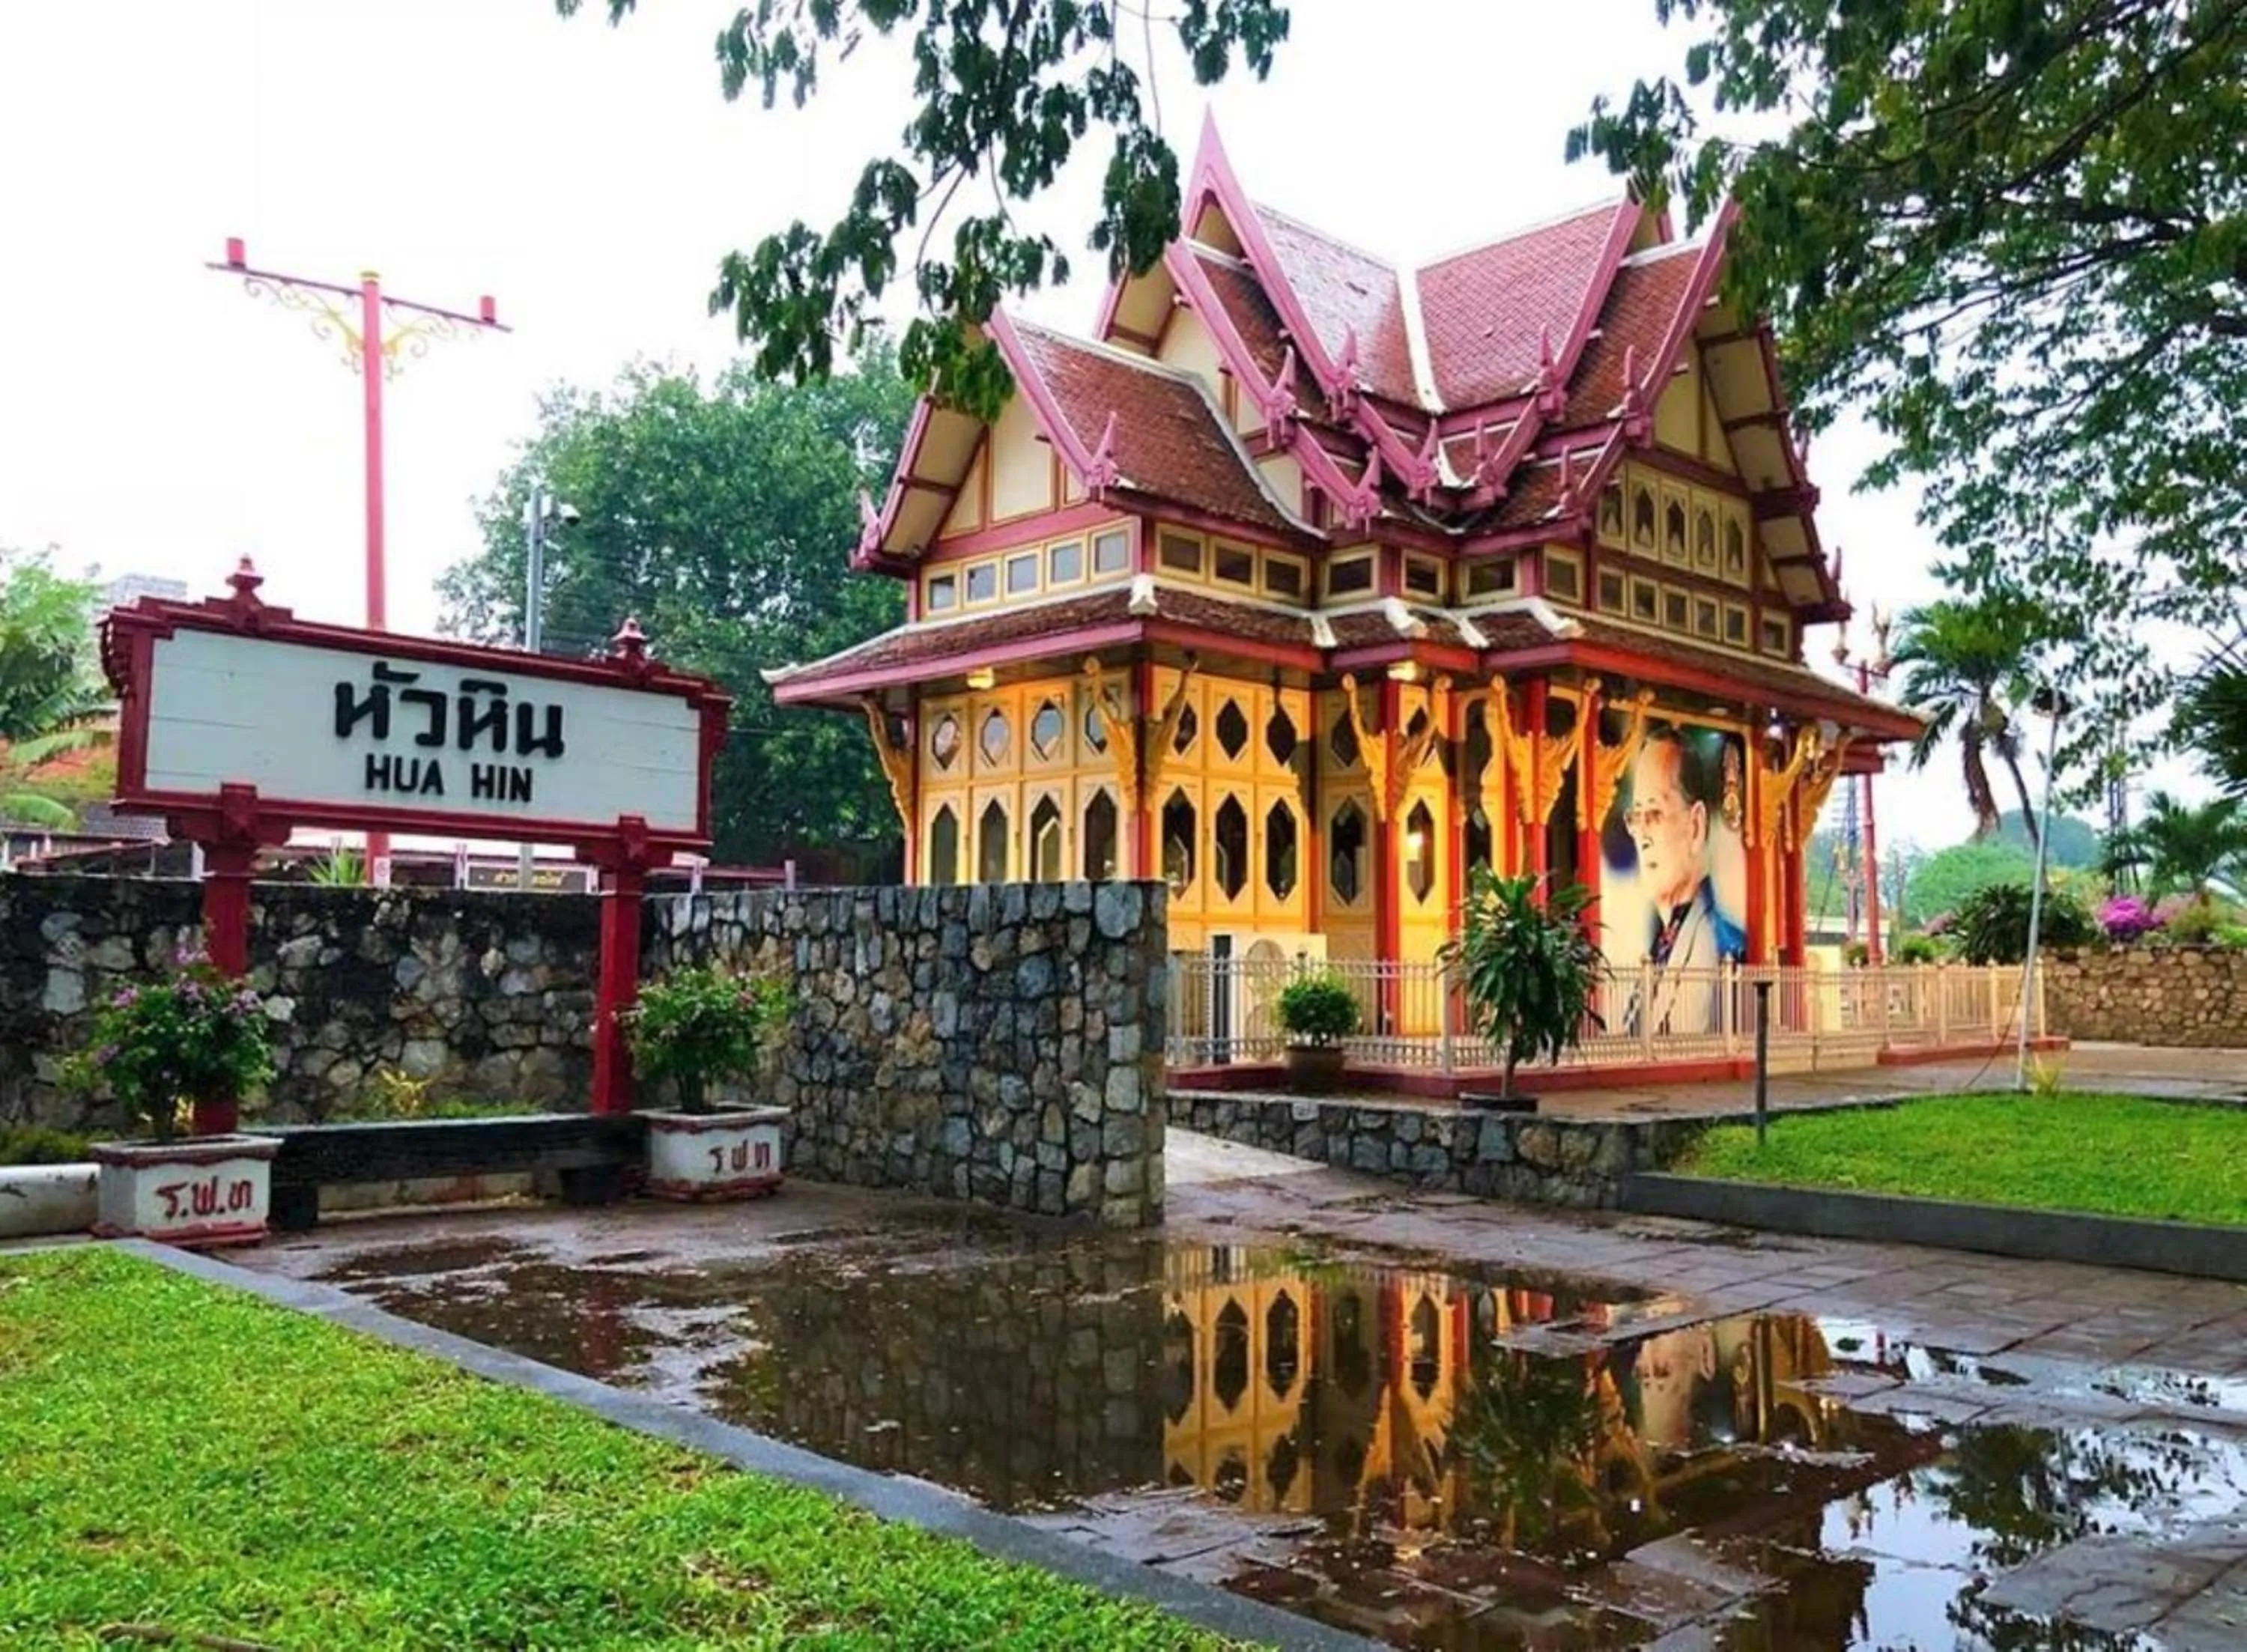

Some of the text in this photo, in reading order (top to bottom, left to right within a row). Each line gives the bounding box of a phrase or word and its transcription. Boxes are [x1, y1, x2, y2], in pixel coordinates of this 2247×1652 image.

[335, 661, 565, 759] หัวหิน
[366, 753, 533, 803] HUA HIN
